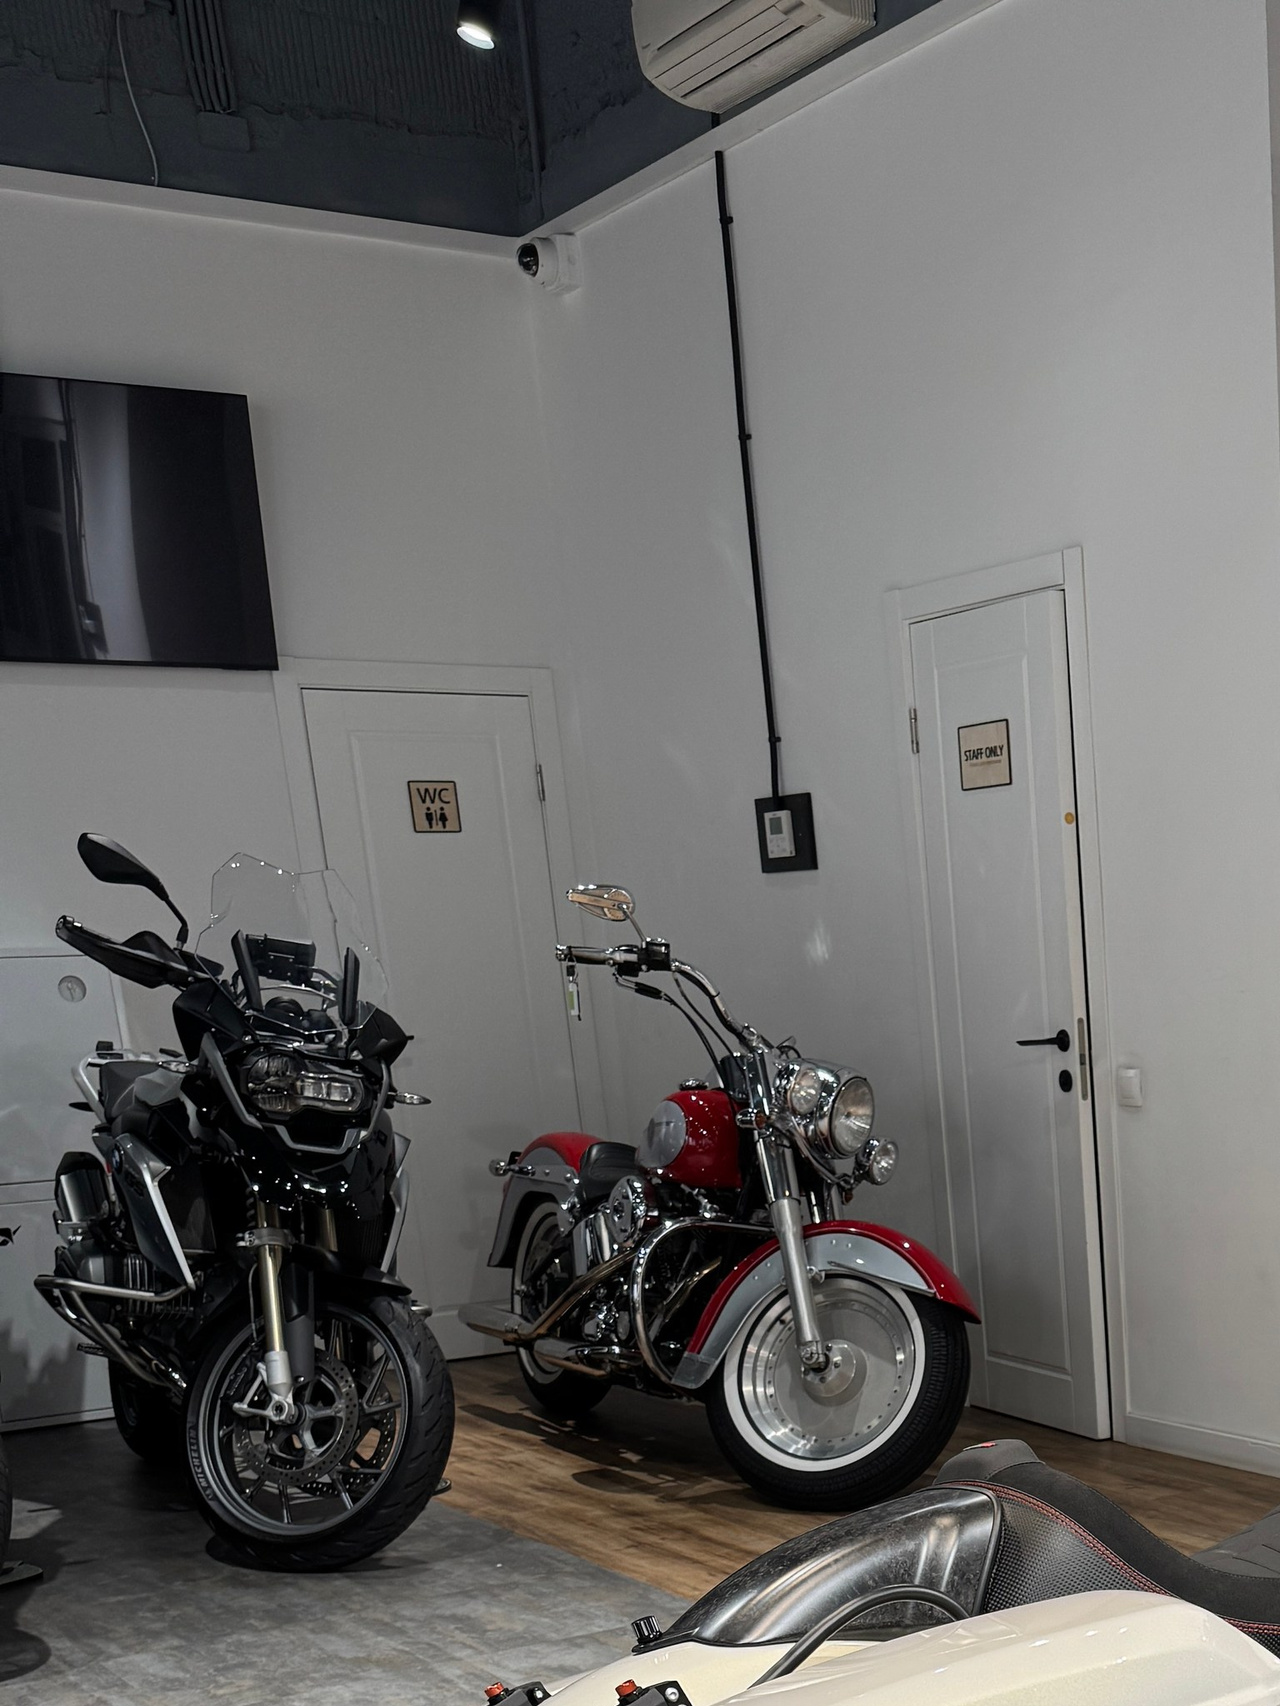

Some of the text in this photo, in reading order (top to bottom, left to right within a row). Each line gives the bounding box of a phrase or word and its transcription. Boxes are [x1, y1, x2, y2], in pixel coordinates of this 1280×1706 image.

[963, 745, 1005, 761] STAFF ONLY
[416, 788, 451, 804] WC
[189, 1429, 208, 1488] MICHELIN
